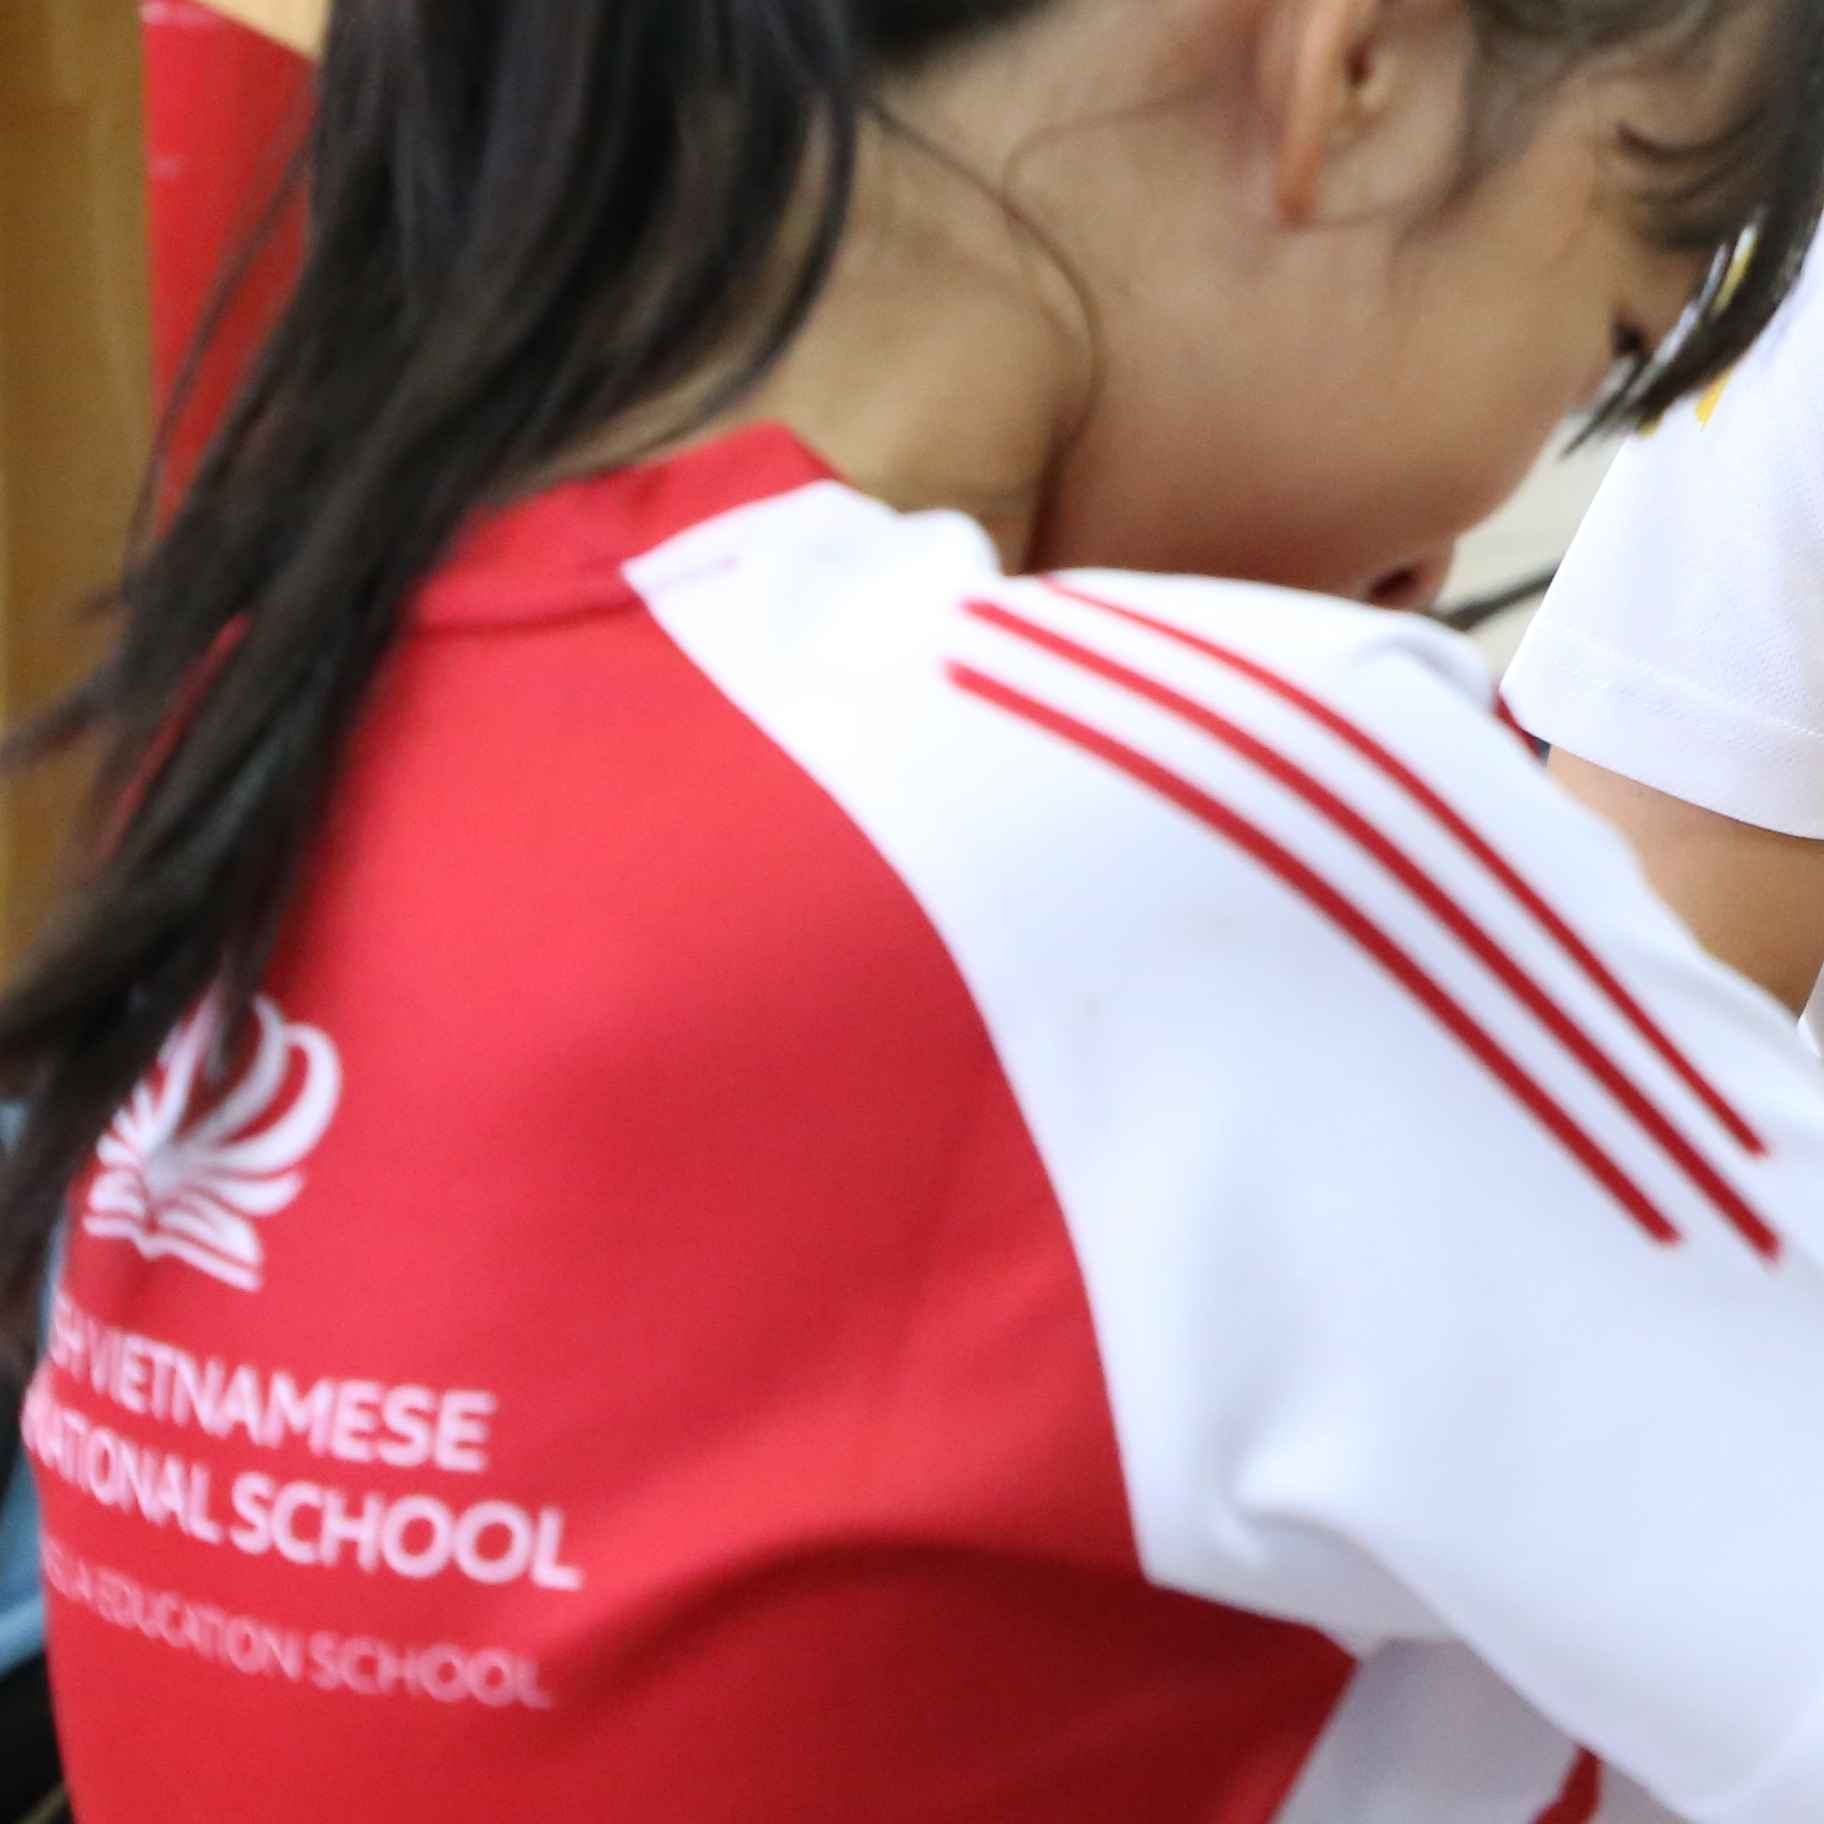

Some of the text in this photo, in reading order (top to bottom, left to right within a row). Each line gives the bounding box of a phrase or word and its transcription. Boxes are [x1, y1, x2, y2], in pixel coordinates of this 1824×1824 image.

[88, 1316, 497, 1473] VIETNAMESE
[230, 1470, 584, 1592] SCHOOL
[307, 1631, 554, 1711] SCHOOL
